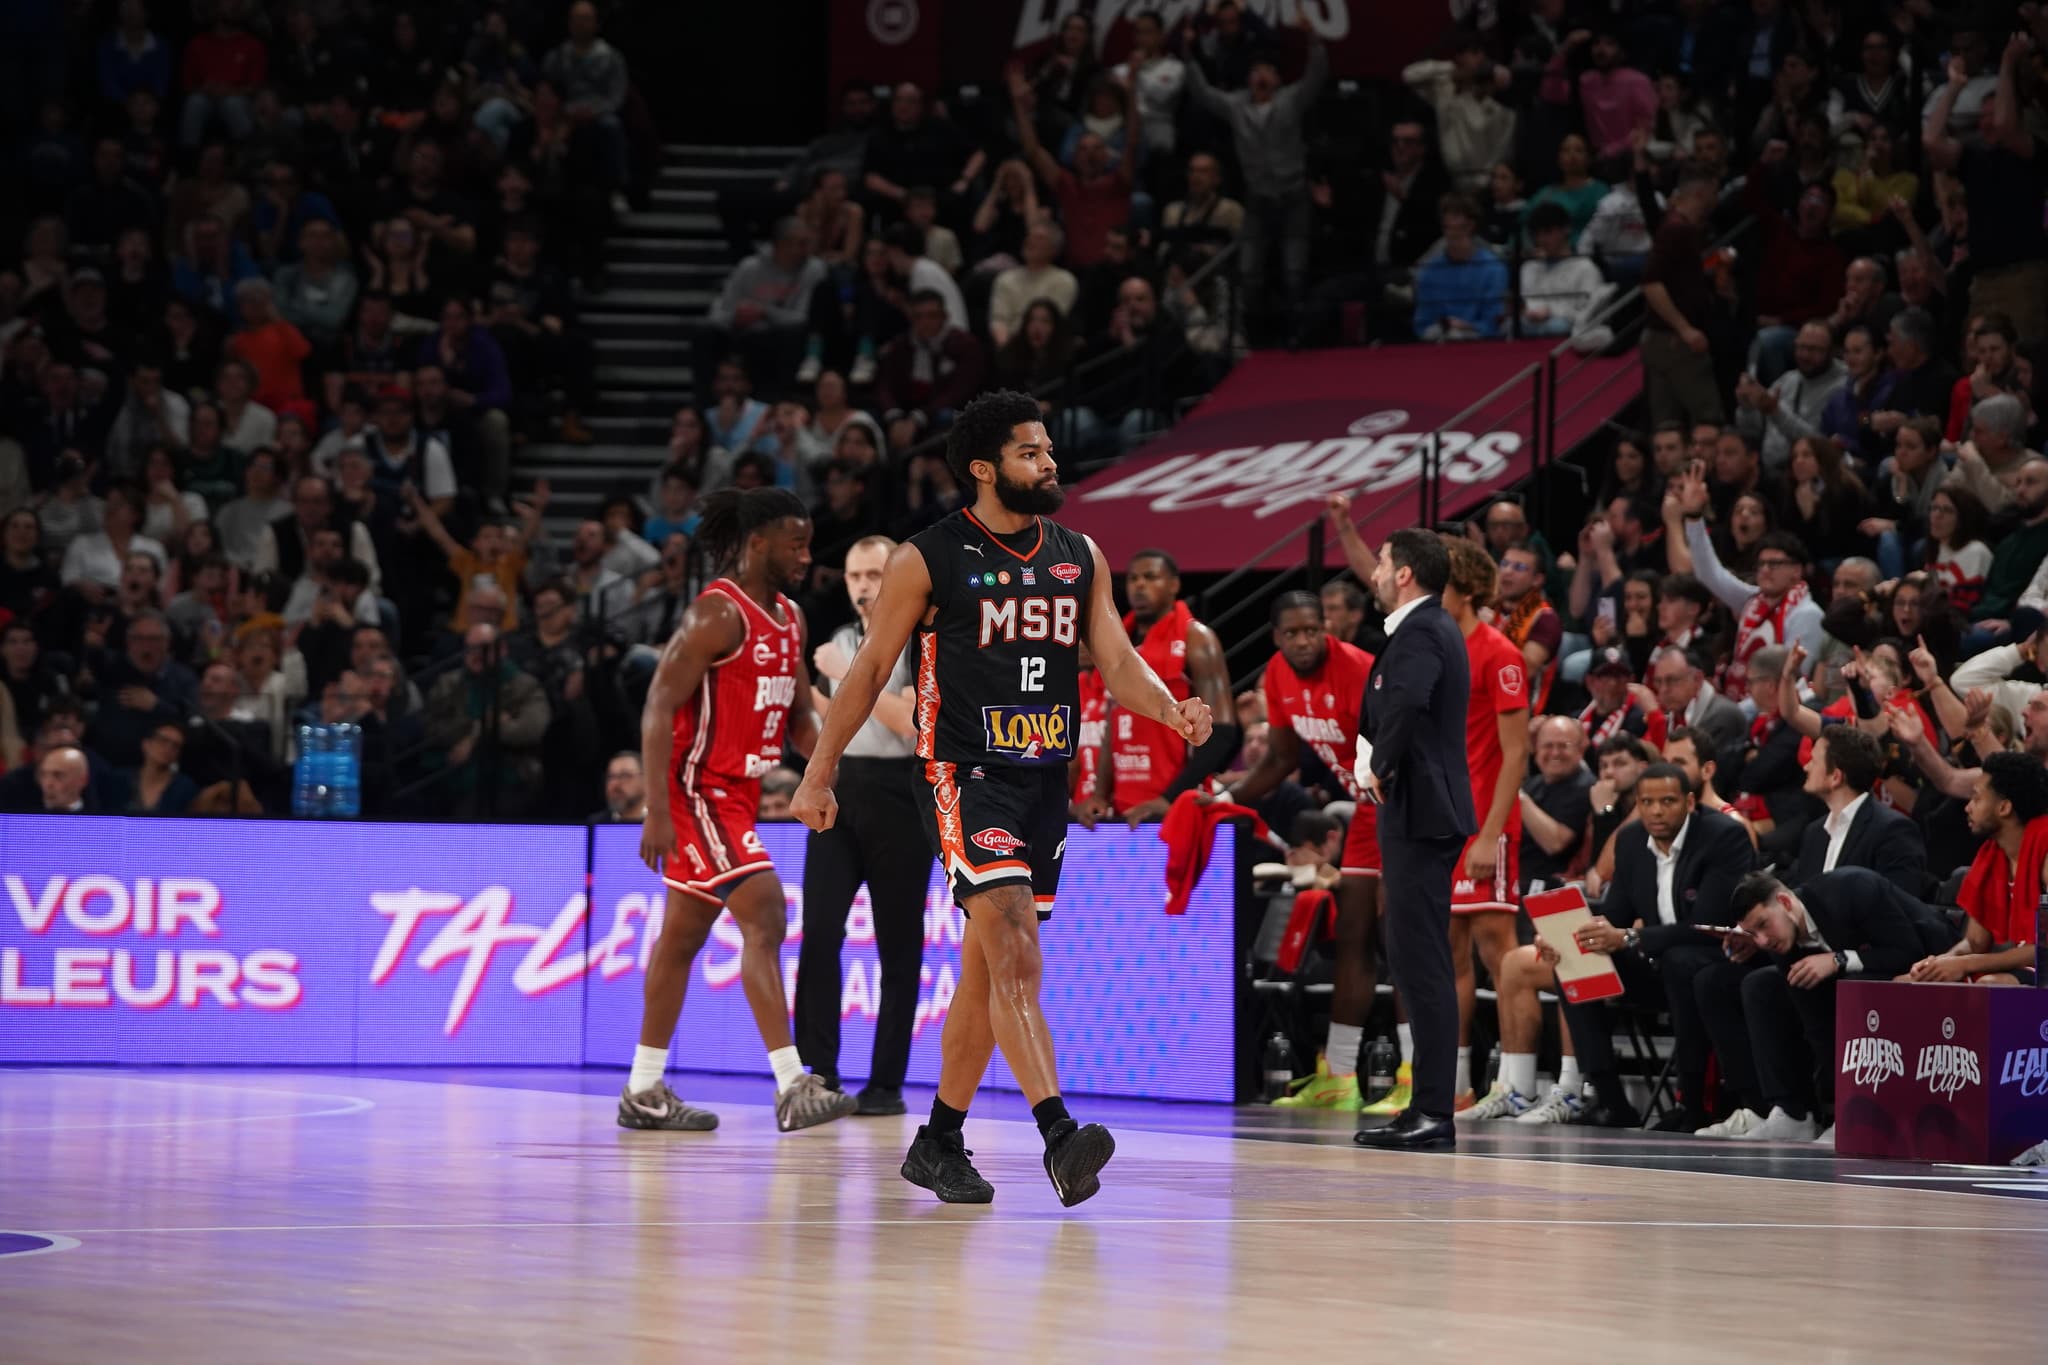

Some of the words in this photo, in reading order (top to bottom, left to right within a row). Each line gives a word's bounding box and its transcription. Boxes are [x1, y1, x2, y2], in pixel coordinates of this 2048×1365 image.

[978, 596, 1080, 649] MSB
[1020, 656, 1046, 692] 12
[989, 703, 1067, 750] Loué
[3, 873, 224, 938] VOIR
[0, 947, 304, 1012] LEURS
[369, 886, 746, 1037] TALES
[1841, 1037, 1905, 1078] LEADERS
[1854, 1055, 1891, 1095] Cup
[1915, 1044, 1981, 1086] LEADERS
[1928, 1063, 1967, 1103] Cup
